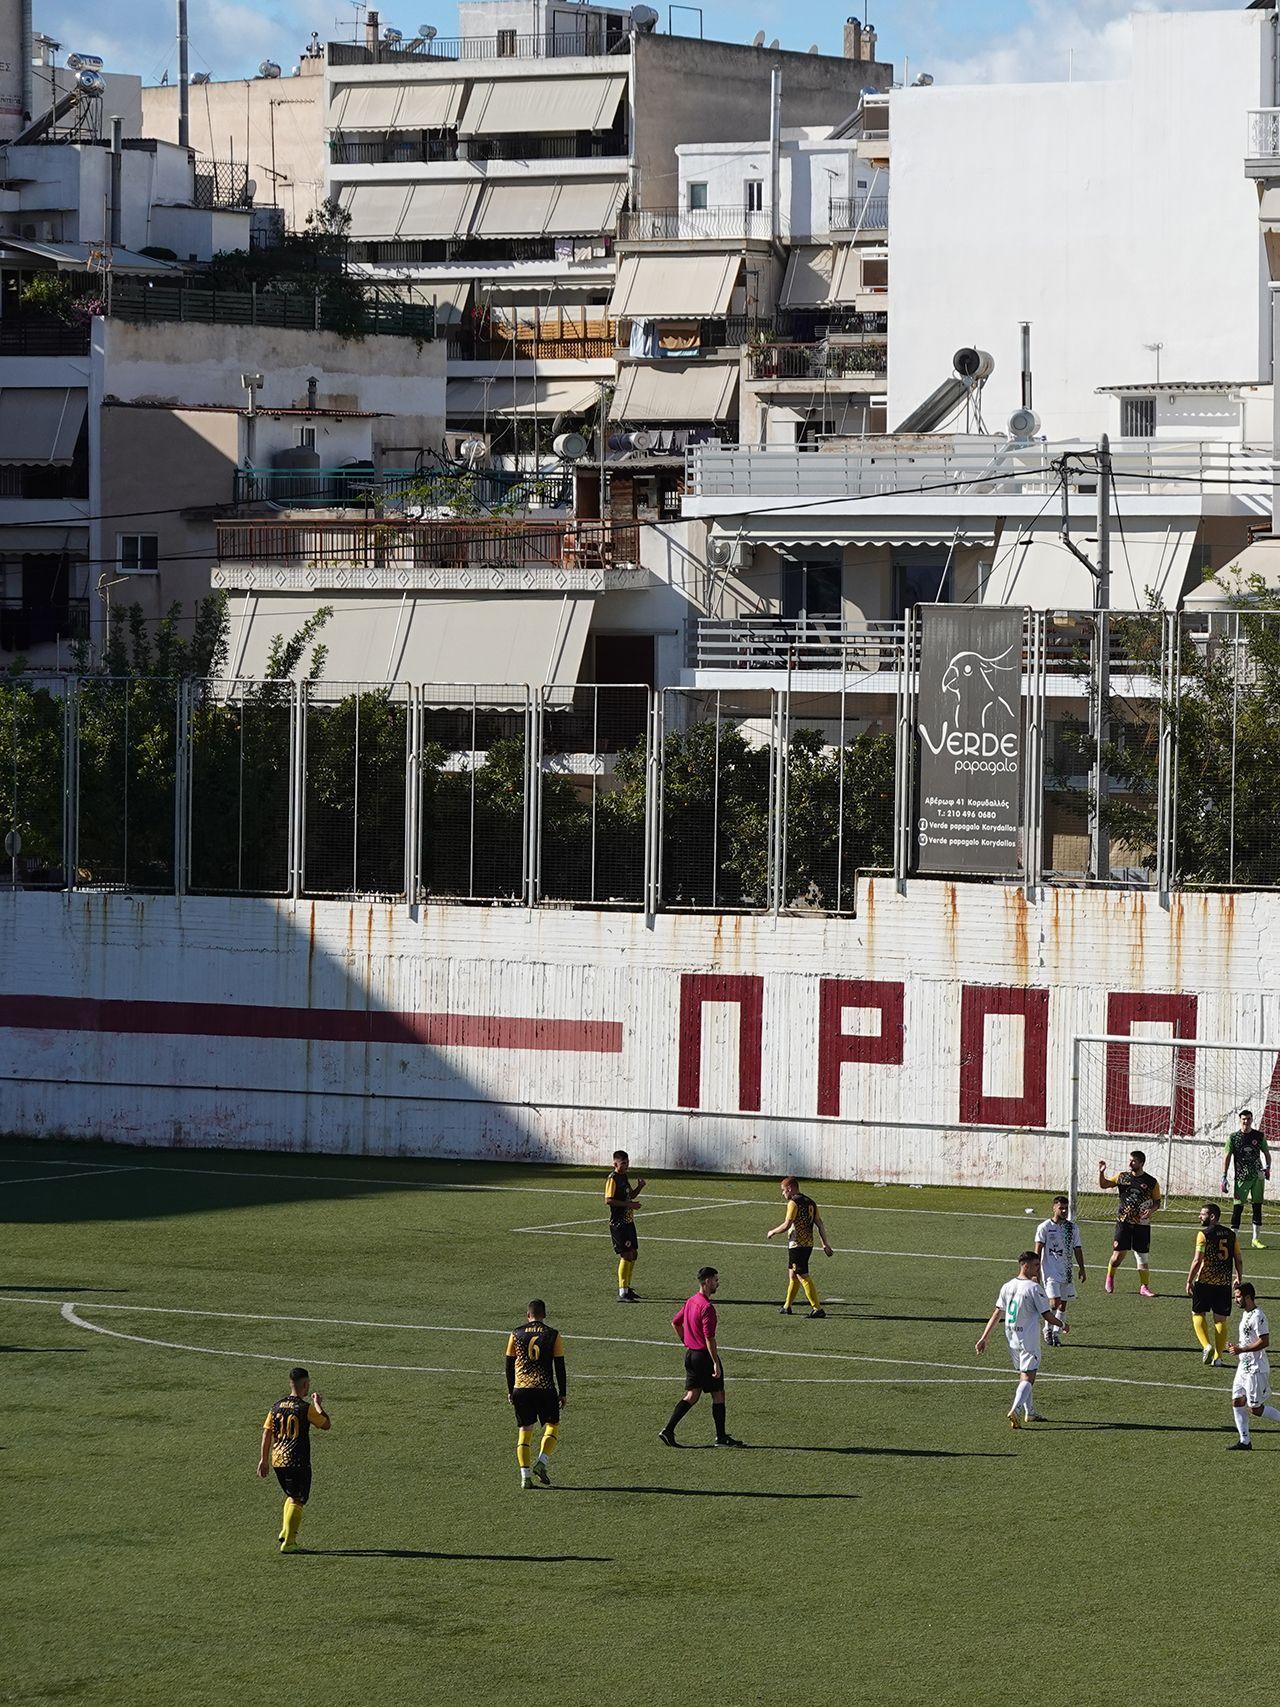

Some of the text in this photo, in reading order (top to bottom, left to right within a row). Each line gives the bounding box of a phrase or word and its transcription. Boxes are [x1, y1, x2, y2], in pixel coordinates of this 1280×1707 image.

[919, 721, 1018, 757] VERDE
[954, 758, 1018, 776] papagalo
[956, 798, 965, 806] 41
[947, 809, 961, 817] 210
[962, 810, 976, 818] 496
[977, 811, 997, 819] 0680
[928, 821, 1017, 833] Verde papagalo Korydallos
[928, 836, 1016, 848] Verde papagalo Korydallos
[1218, 1238, 1229, 1261] 5
[527, 1335, 541, 1361] 6
